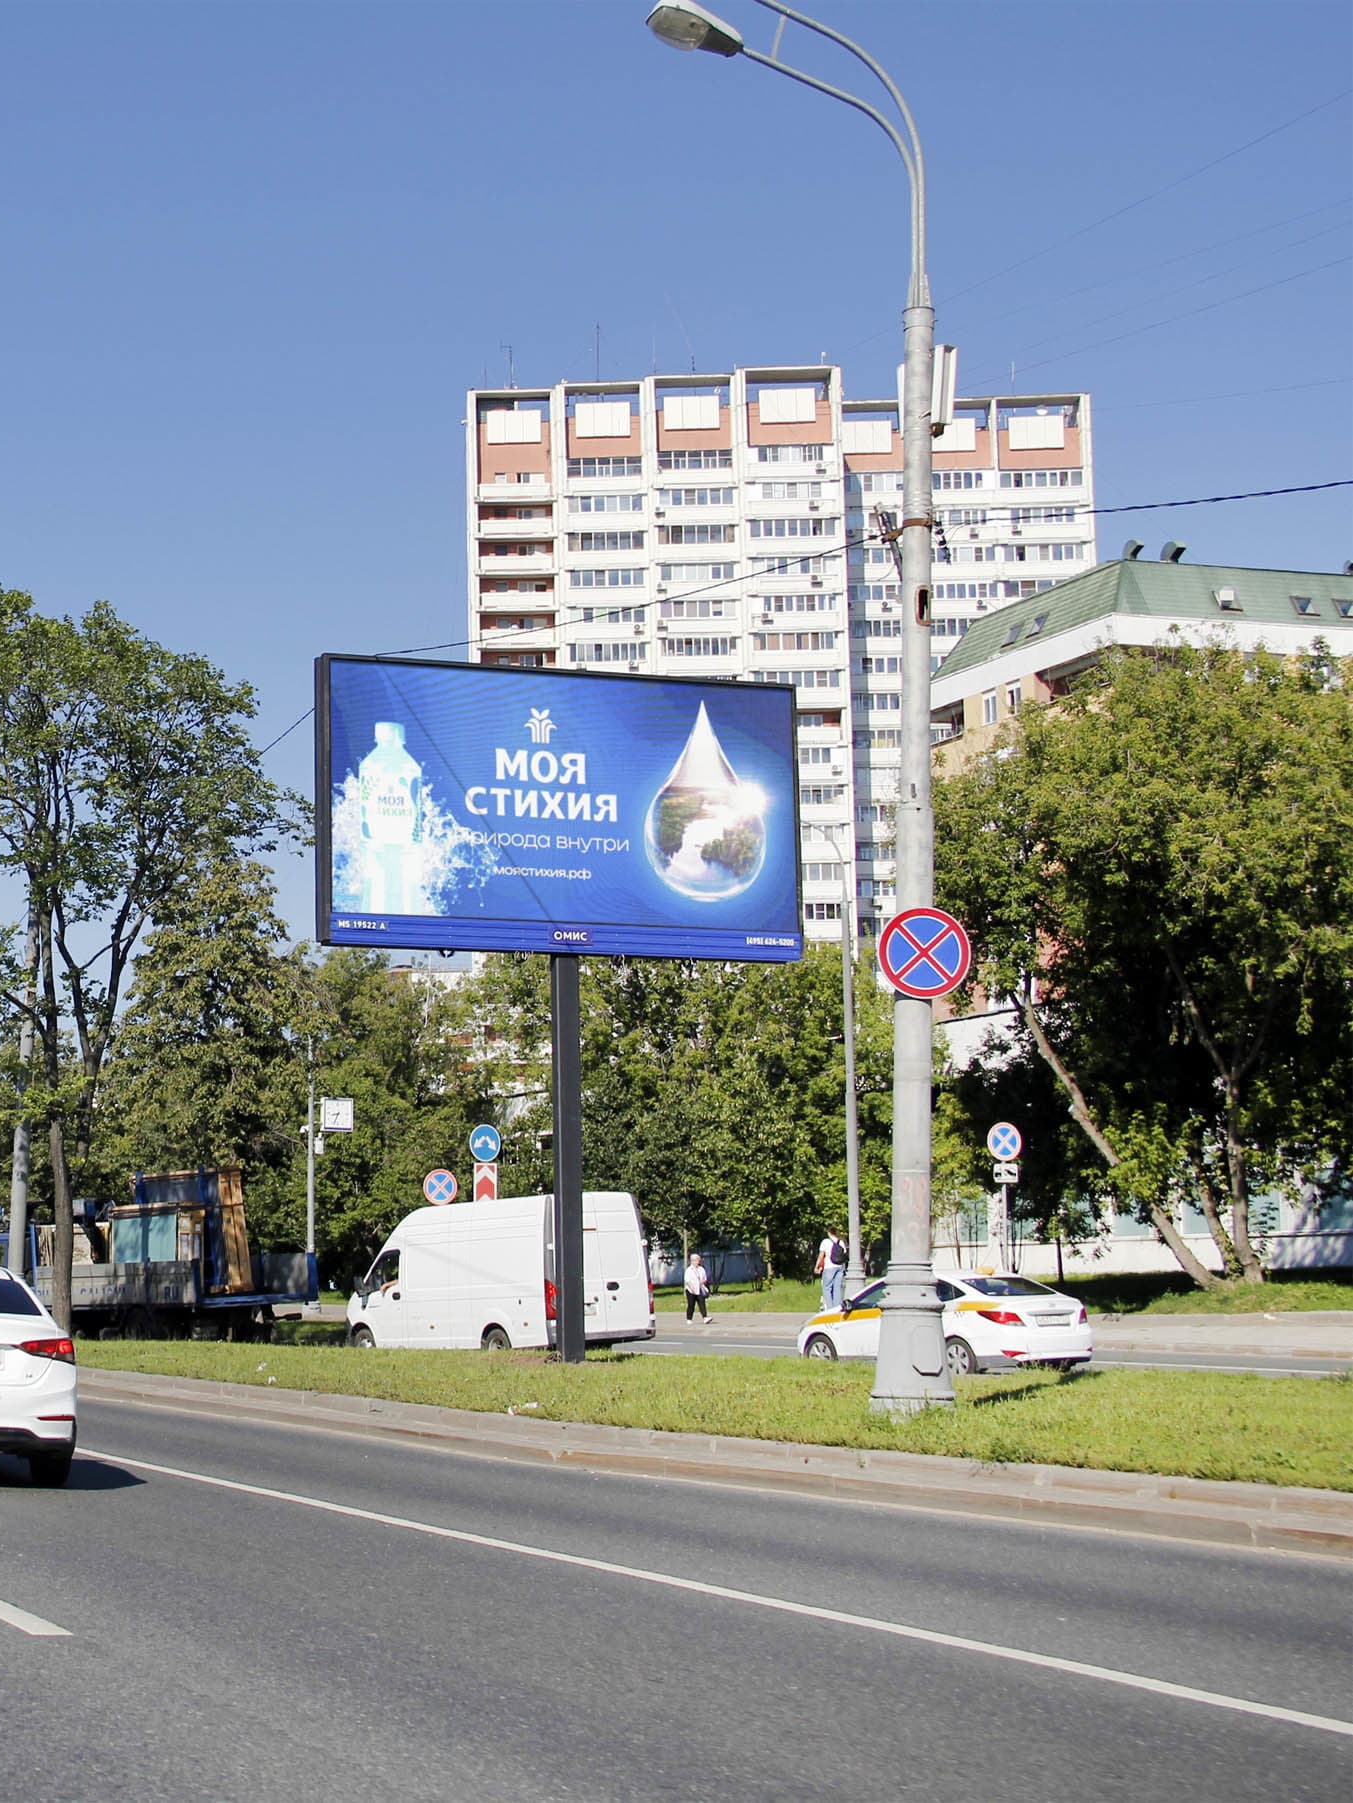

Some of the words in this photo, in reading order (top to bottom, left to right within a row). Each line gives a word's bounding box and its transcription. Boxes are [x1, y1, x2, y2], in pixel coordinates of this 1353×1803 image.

[495, 748, 586, 784] МОЯ
[378, 796, 405, 806] МОЯ
[464, 786, 618, 822] СТИХИЯ
[556, 835, 630, 853] внутри
[494, 866, 592, 880] моястихия.рф
[353, 920, 377, 929] 19522
[553, 931, 588, 941] ОМИС
